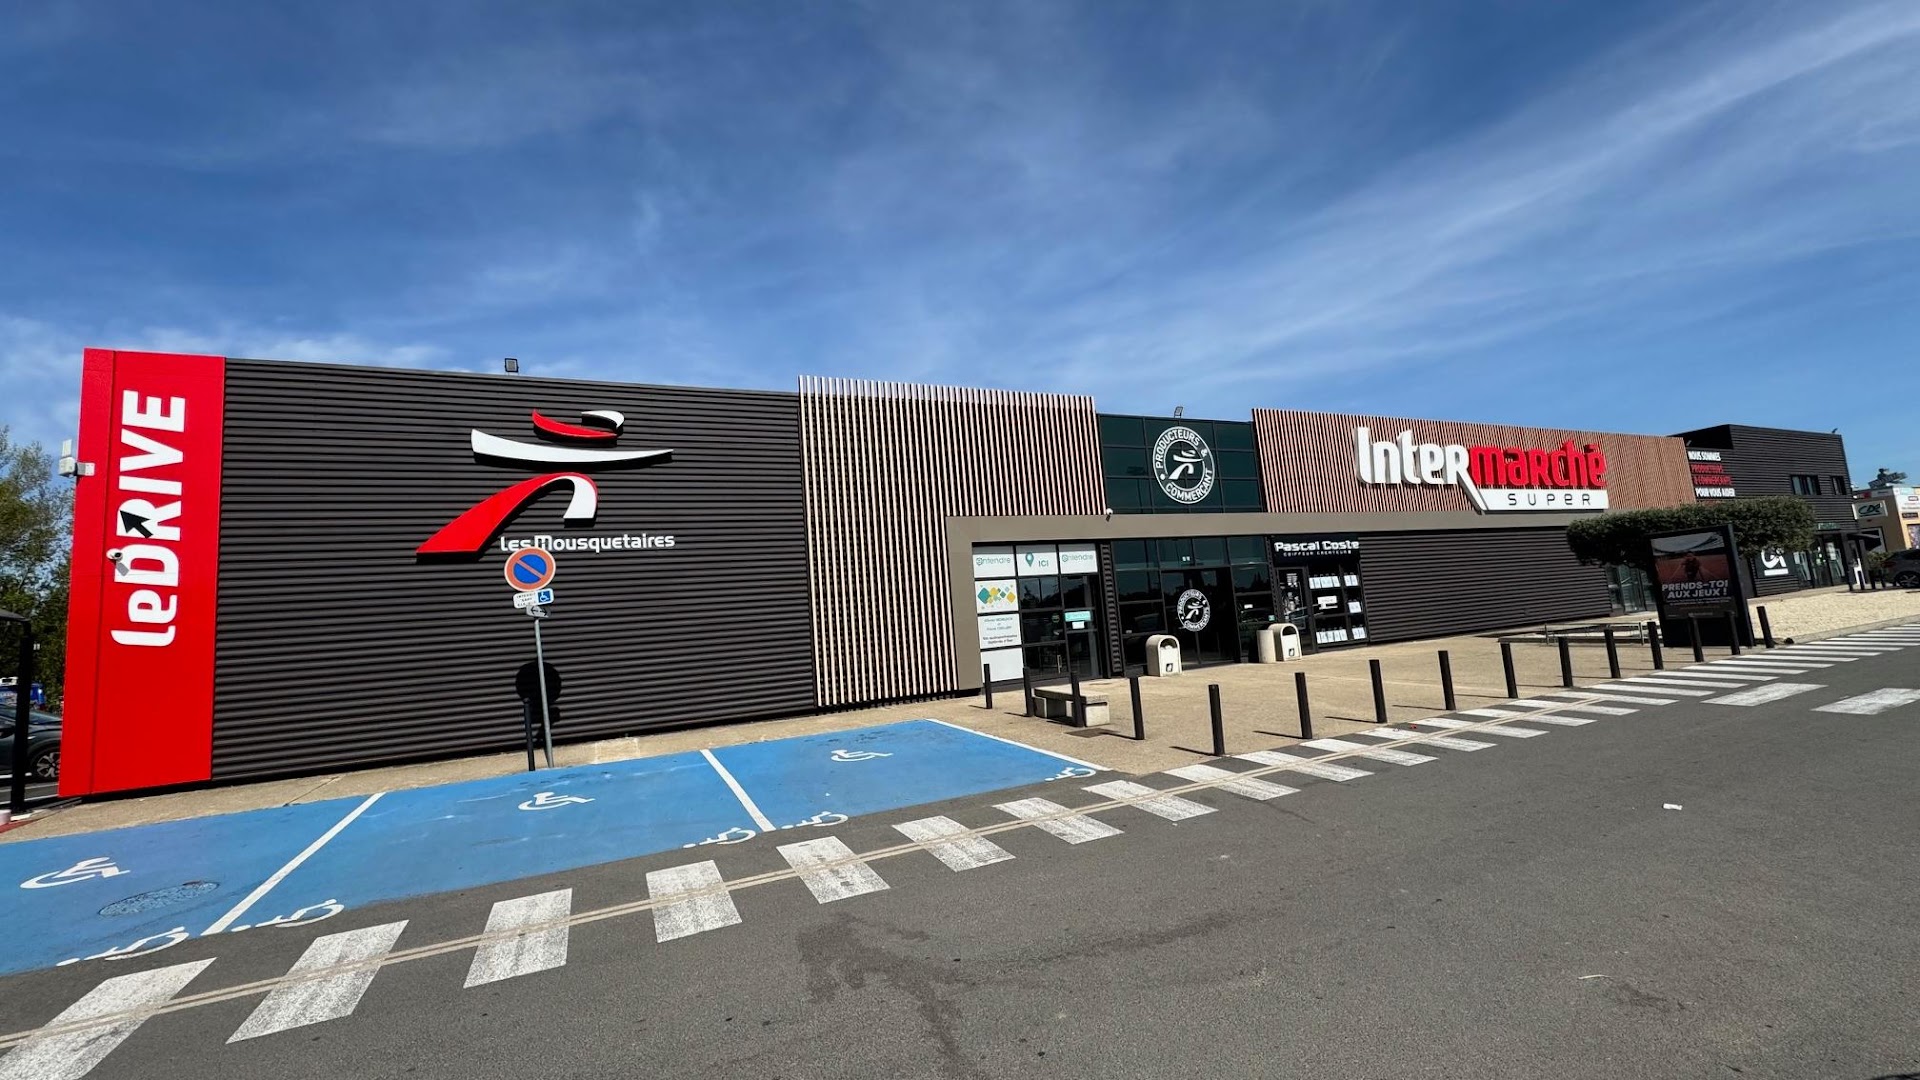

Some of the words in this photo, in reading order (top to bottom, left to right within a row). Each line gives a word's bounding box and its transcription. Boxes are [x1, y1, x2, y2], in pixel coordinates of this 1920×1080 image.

[1155, 429, 1200, 469] PRODUCTEURS
[533, 533, 676, 553] Mousquetaires
[1274, 541, 1320, 552] Pascal
[1321, 540, 1360, 550] Coste
[1038, 560, 1049, 568] ICI
[1661, 579, 1729, 592] PRENDS-TOI
[1667, 590, 1691, 599] AUX
[1691, 588, 1720, 597] JEUX
